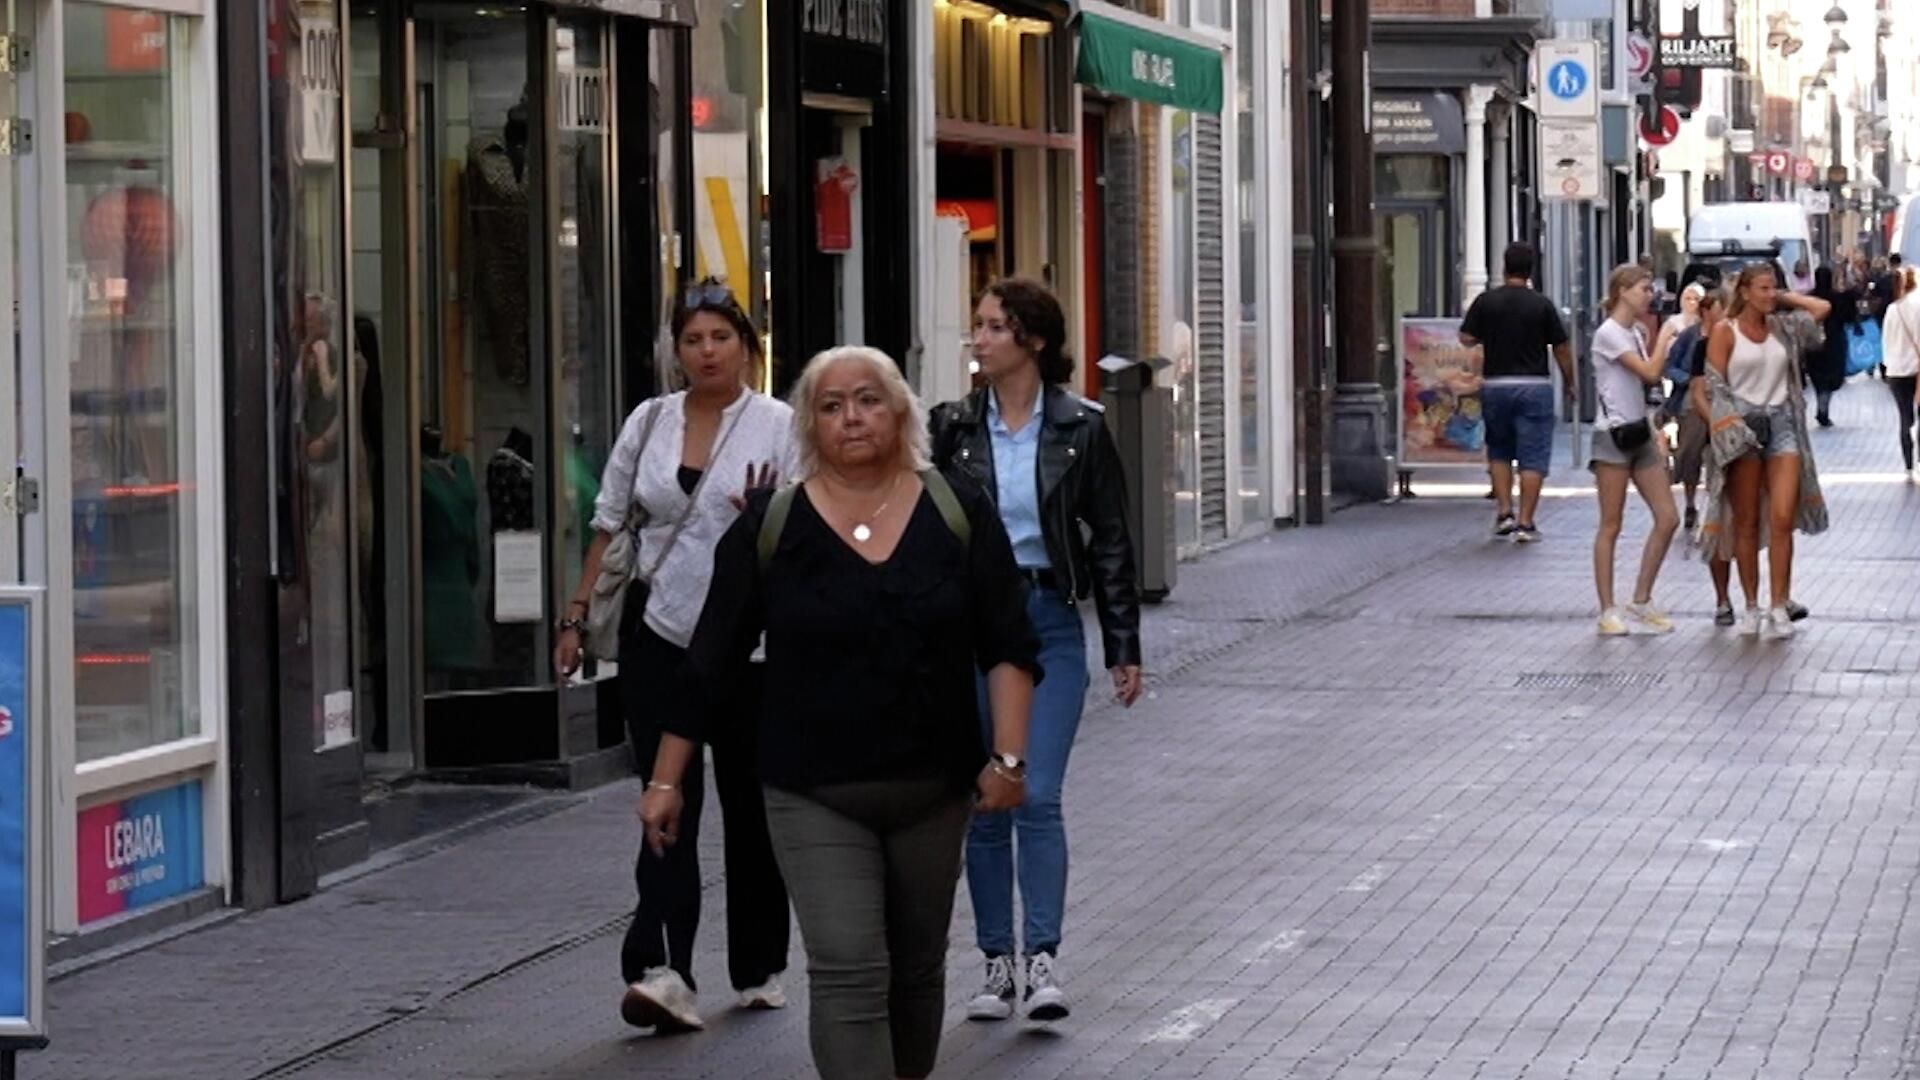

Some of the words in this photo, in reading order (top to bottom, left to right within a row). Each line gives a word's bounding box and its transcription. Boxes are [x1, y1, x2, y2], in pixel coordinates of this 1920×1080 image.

[803, 0, 842, 36] PIDE
[846, 0, 883, 45] HUIS
[105, 814, 165, 869] LEBARA
